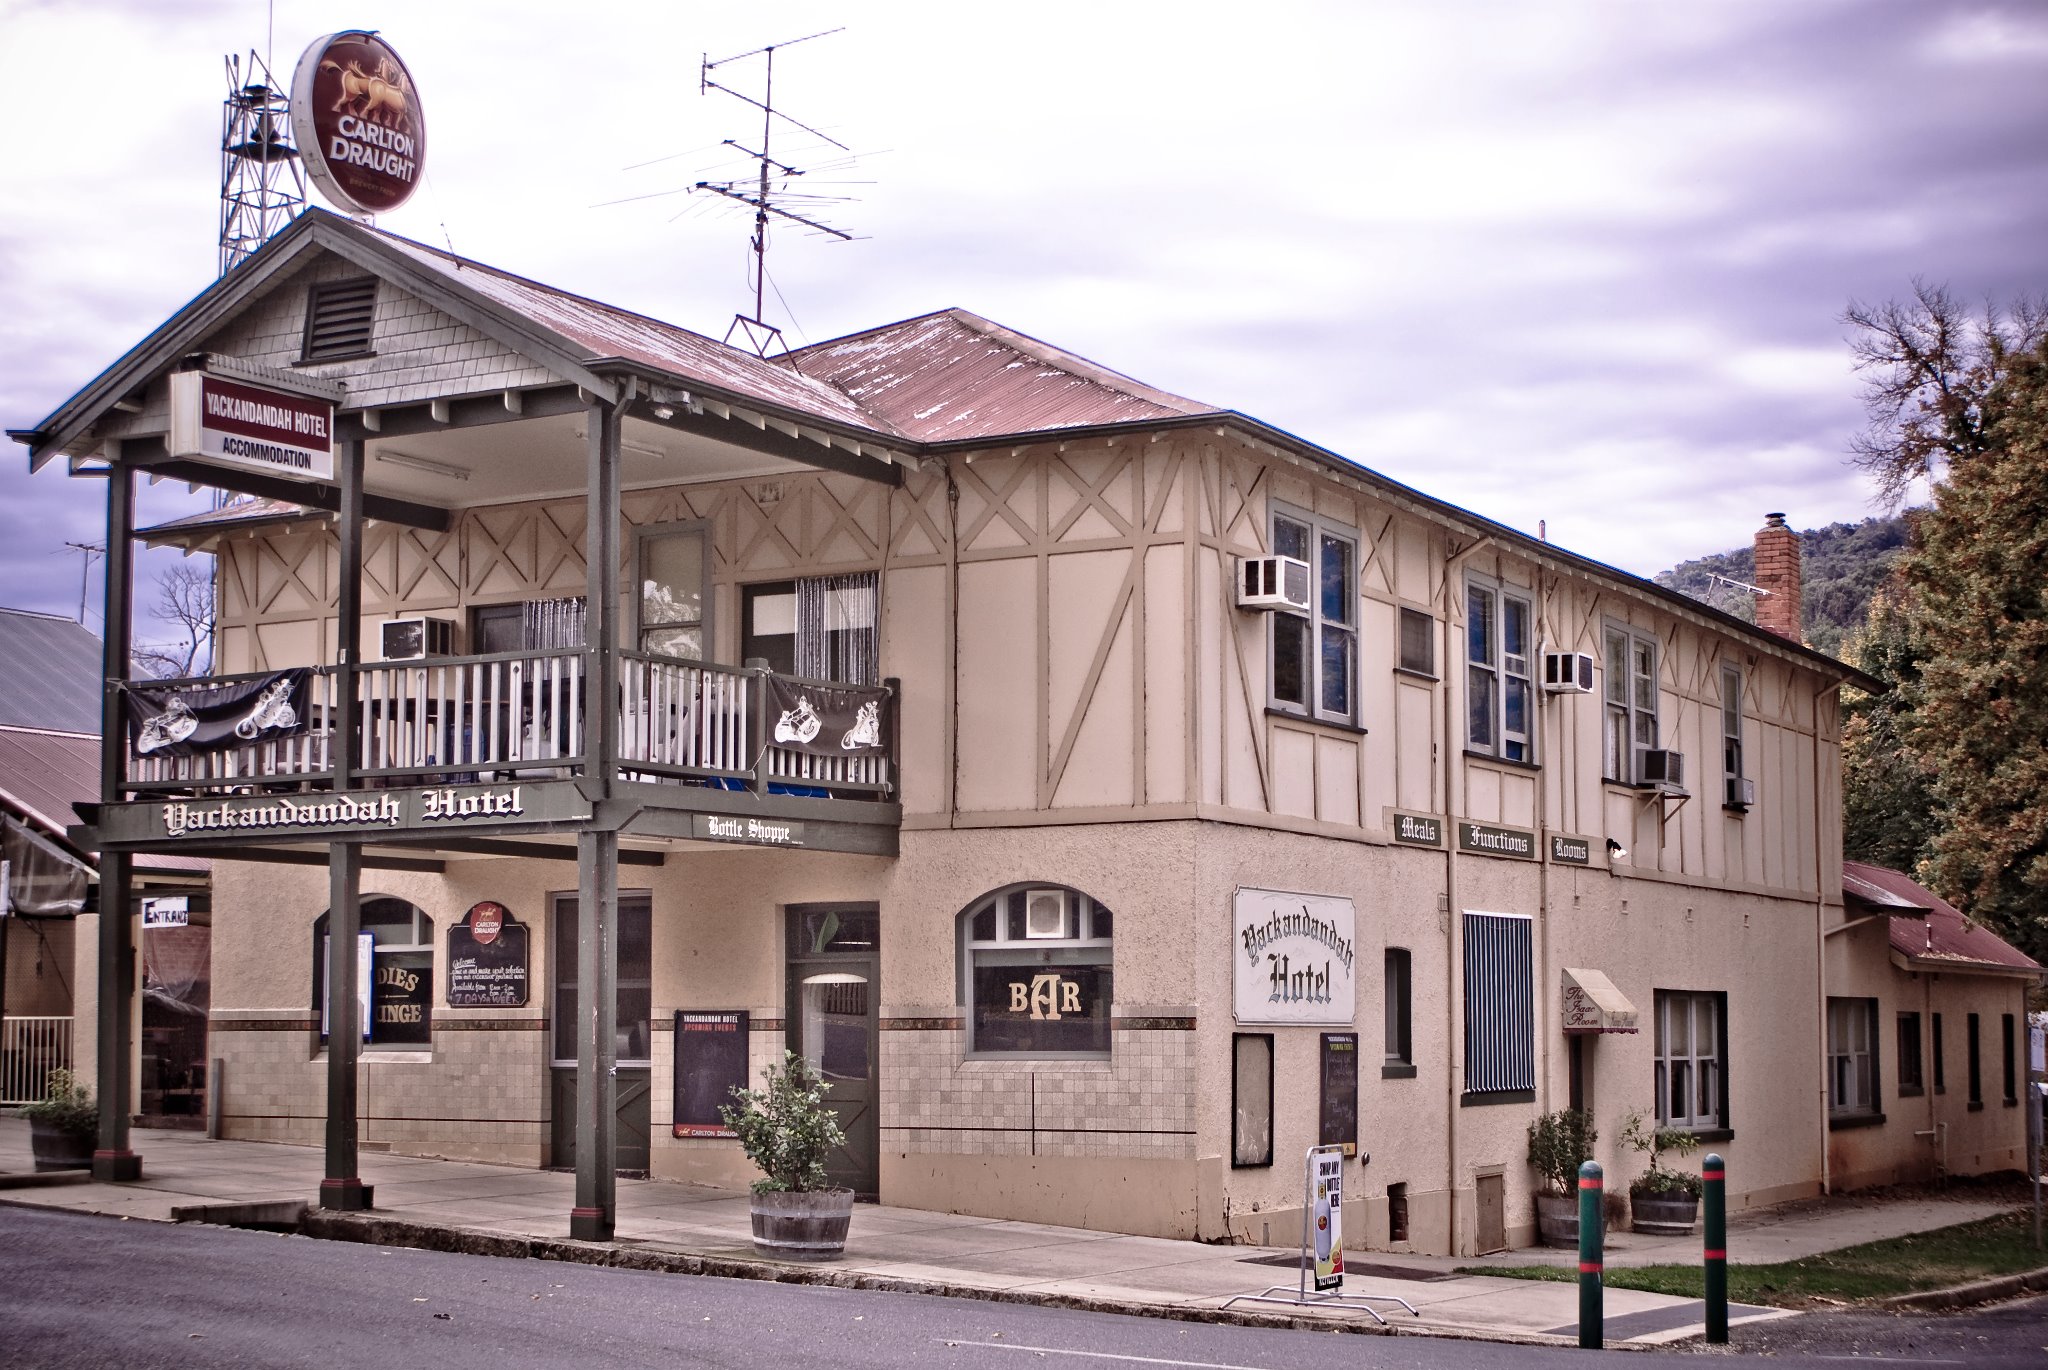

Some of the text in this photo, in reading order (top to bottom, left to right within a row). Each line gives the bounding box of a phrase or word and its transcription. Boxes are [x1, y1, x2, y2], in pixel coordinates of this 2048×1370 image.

[337, 115, 414, 158] CARLTON
[330, 136, 415, 183] DRAUGHT
[207, 392, 327, 438] YACKANDANDAH HOTEL
[223, 437, 311, 470] ACCOMMODATION
[163, 786, 524, 836] Yackandandah Hotel
[708, 815, 790, 843] Bottle Shoppe
[1402, 816, 1435, 841] Meals
[1470, 825, 1528, 852] Functions
[1555, 838, 1587, 860] Rooms
[1242, 905, 1353, 980] Yackandandah
[377, 967, 419, 991] DIES
[1267, 952, 1332, 1004] Hotel
[1565, 986, 1584, 1000] The
[1008, 974, 1082, 1020] BAR
[1567, 1013, 1598, 1026] Room
[691, 1129, 715, 1137] CARLTON
